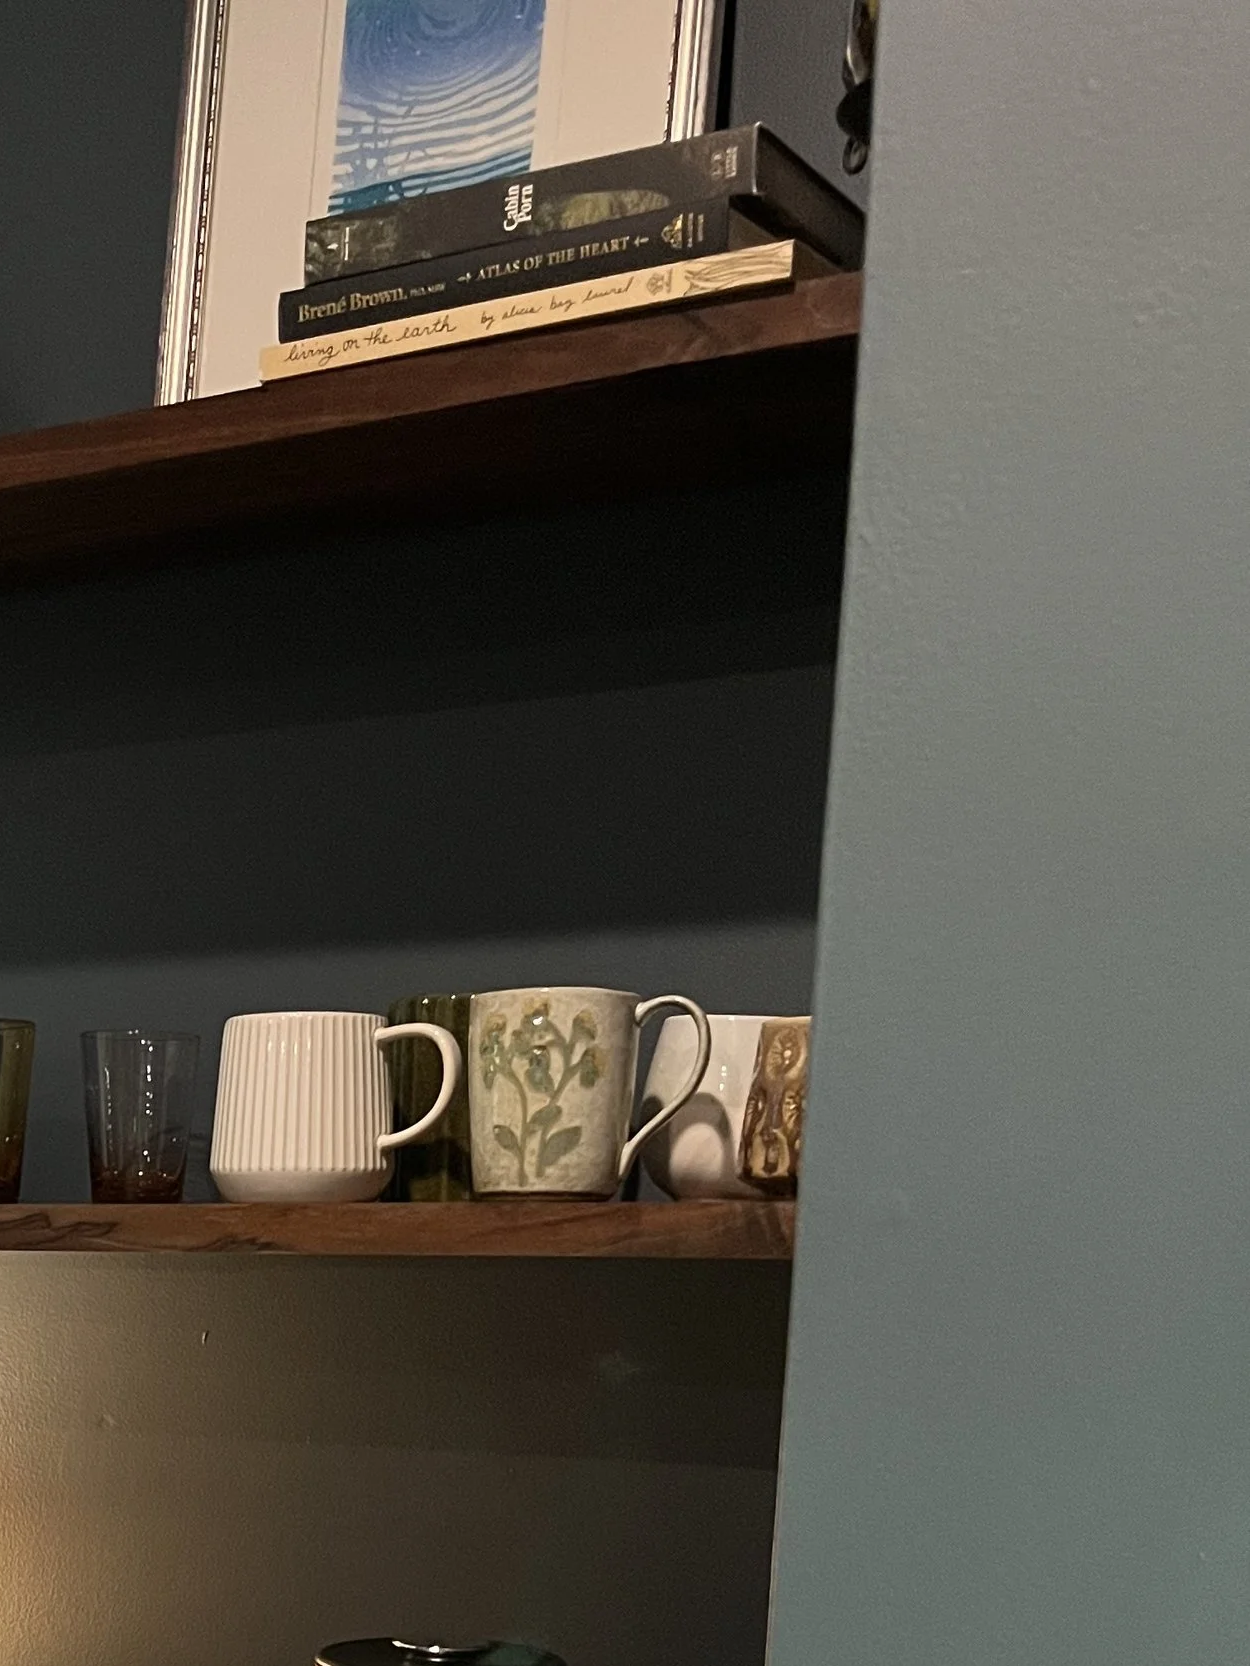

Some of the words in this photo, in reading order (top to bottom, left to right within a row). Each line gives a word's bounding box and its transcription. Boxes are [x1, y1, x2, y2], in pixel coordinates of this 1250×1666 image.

[503, 184, 520, 231] Cabin
[517, 184, 534, 223] Porn
[475, 259, 521, 281] ATLAS
[523, 254, 546, 272] OF
[548, 247, 576, 266] THE
[579, 235, 630, 259] HEART
[297, 296, 347, 323] Brené
[284, 343, 340, 367] living
[342, 339, 360, 352] on
[363, 326, 393, 346] the
[395, 314, 458, 342] earth
[480, 310, 495, 331] by
